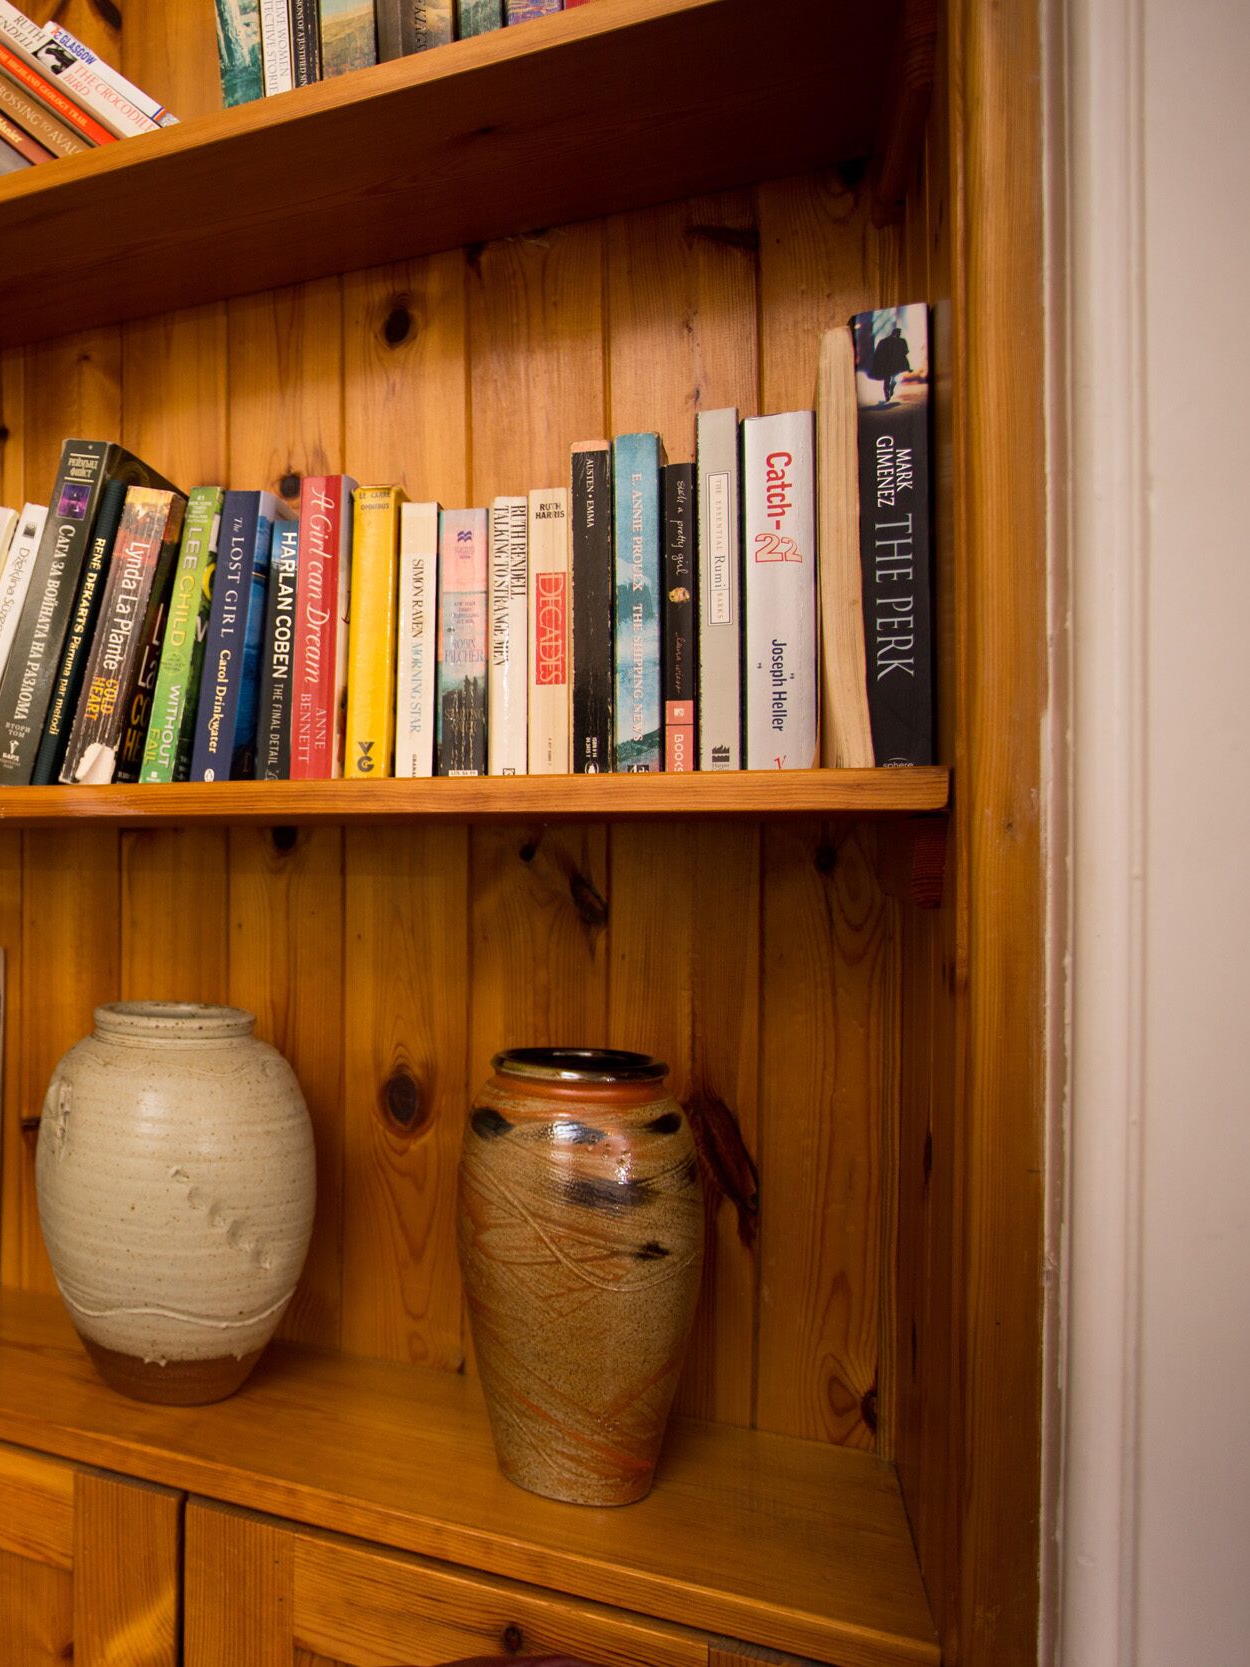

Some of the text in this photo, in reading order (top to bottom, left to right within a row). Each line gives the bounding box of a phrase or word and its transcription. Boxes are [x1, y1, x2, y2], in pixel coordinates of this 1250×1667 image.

[13, 15, 46, 43] RUTH
[59, 34, 98, 66] GLASGOW
[267, 50, 279, 93] STORIE
[278, 28, 289, 77] WOMEN
[296, 38, 307, 75] JUSTIFIED
[6, 57, 42, 90] HIGHLAND
[39, 83, 71, 113] GEOLOGY
[68, 106, 89, 128] TRAIL
[62, 73, 91, 98] BIRD
[73, 64, 96, 86] THE
[876, 435, 895, 509] GIMENEZ
[898, 448, 913, 492] MARK
[535, 510, 565, 519] HARRIS
[539, 502, 562, 511] RUTH
[586, 459, 595, 528] AUSTEN EMMA
[631, 492, 643, 532] ANNIE
[309, 513, 335, 558] Girl
[670, 519, 687, 549] pretty
[714, 500, 724, 551] ESSENTIAL
[754, 532, 804, 563] 22
[49, 561, 65, 576] ЗА
[181, 527, 203, 570] LEE
[510, 504, 527, 600] RUTH RENDELL
[632, 536, 644, 592] PROULX
[671, 555, 688, 576] girl
[308, 562, 326, 603] can
[493, 504, 510, 666] TALKING TO STRANGE MEN
[714, 555, 726, 589] Rumi
[34, 578, 61, 641] ВОЙНАТА
[74, 572, 97, 634] DEKARTS
[103, 541, 151, 670] Lynda La Plante
[171, 576, 196, 647] CHILD
[632, 603, 643, 632] THE
[716, 592, 724, 620] BARKS
[875, 513, 915, 682] THE PERK
[29, 641, 45, 659] НА
[208, 516, 245, 754] The LOST GIRL Carol Drinkwater
[268, 531, 298, 766] HARLAN COBEN THE FINAL DETAIL
[304, 606, 331, 685] Dream
[409, 558, 425, 734] SIMON RAVEN MORNING STAR
[539, 573, 564, 684] DECADES
[57, 678, 69, 697] par
[632, 636, 644, 699] SHIPPING
[770, 639, 787, 731] Joseph Heller
[13, 662, 40, 720] РАЗЛОМА
[84, 675, 107, 721] HEART
[99, 678, 119, 716] COLD
[8, 729, 25, 738] ТОМ
[49, 697, 65, 737] metodi
[157, 685, 182, 769] WITHOUT
[299, 693, 312, 764] BENNETT
[314, 706, 328, 750] ANNE
[632, 703, 644, 742] NEWS
[144, 727, 161, 768] FAIL
